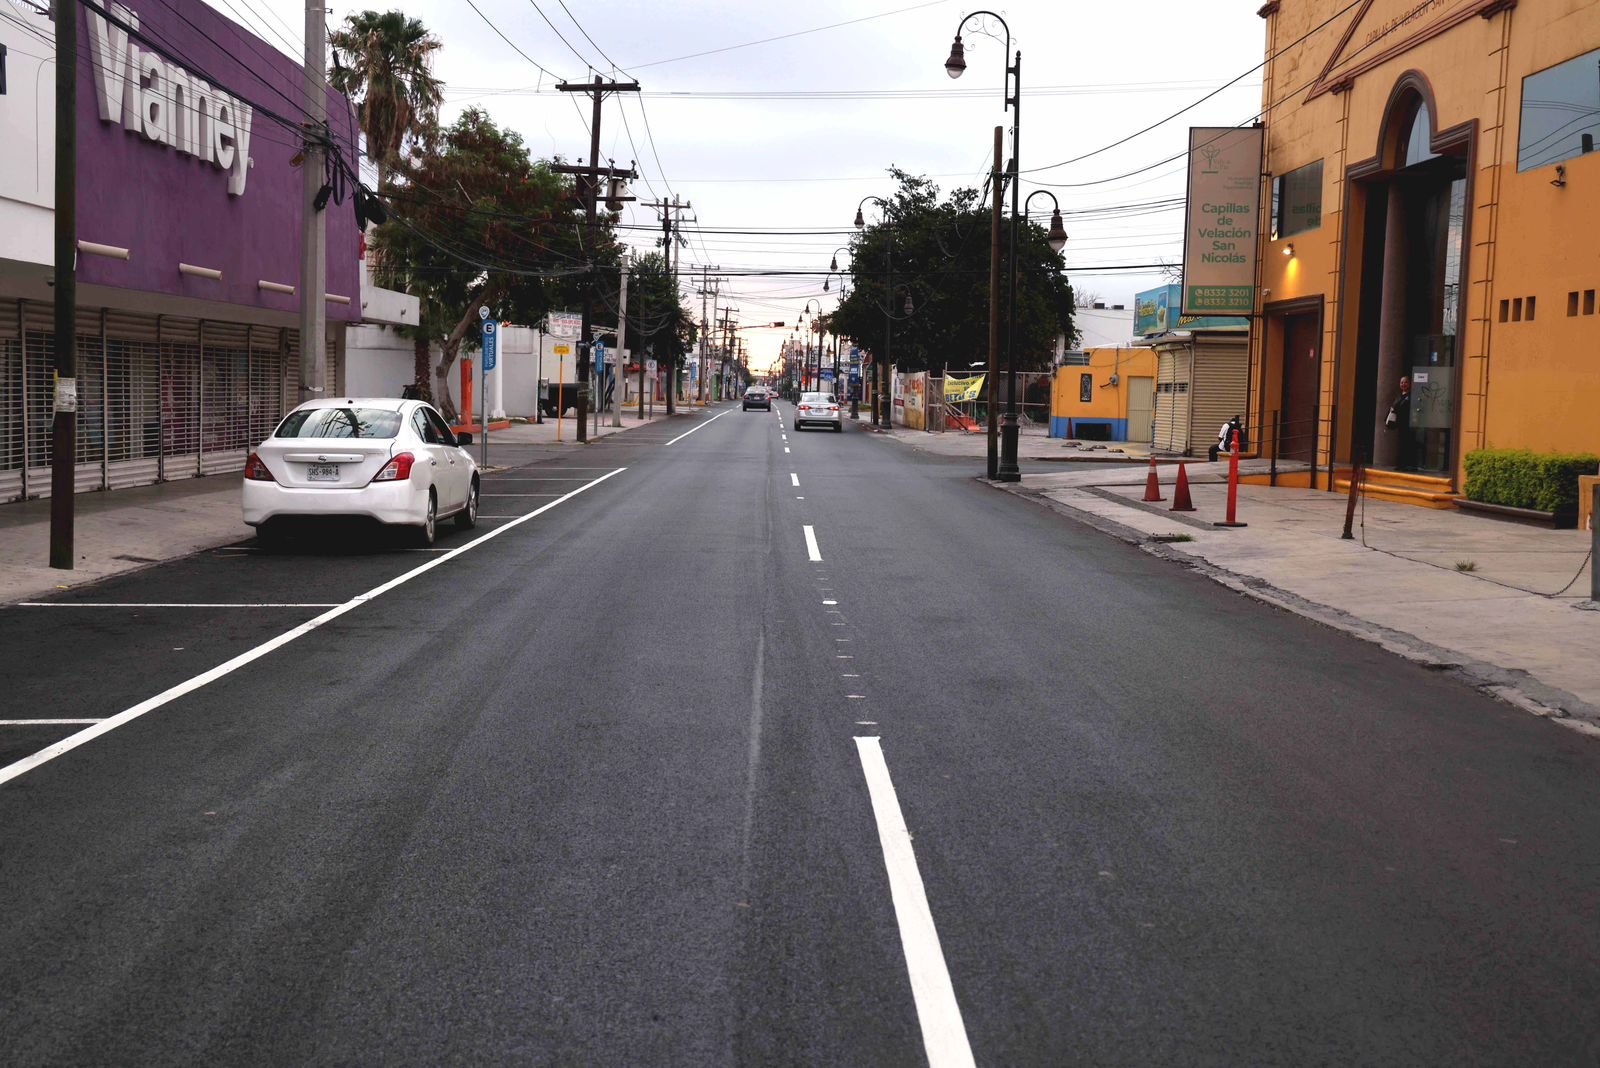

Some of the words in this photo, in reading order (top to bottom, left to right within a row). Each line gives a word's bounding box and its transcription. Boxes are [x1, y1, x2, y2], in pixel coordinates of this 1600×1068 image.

[85, 0, 253, 196] Vianney
[1201, 202, 1250, 215] Capillas
[1217, 215, 1233, 226] de
[1198, 227, 1251, 238] Velación
[1212, 240, 1236, 251] San
[1201, 252, 1246, 263] Nicolás
[1204, 288, 1226, 297] 8332
[1229, 288, 1249, 297] 3201
[1204, 298, 1226, 306] 8332
[1229, 298, 1249, 306] 3210
[486, 324, 493, 333] E
